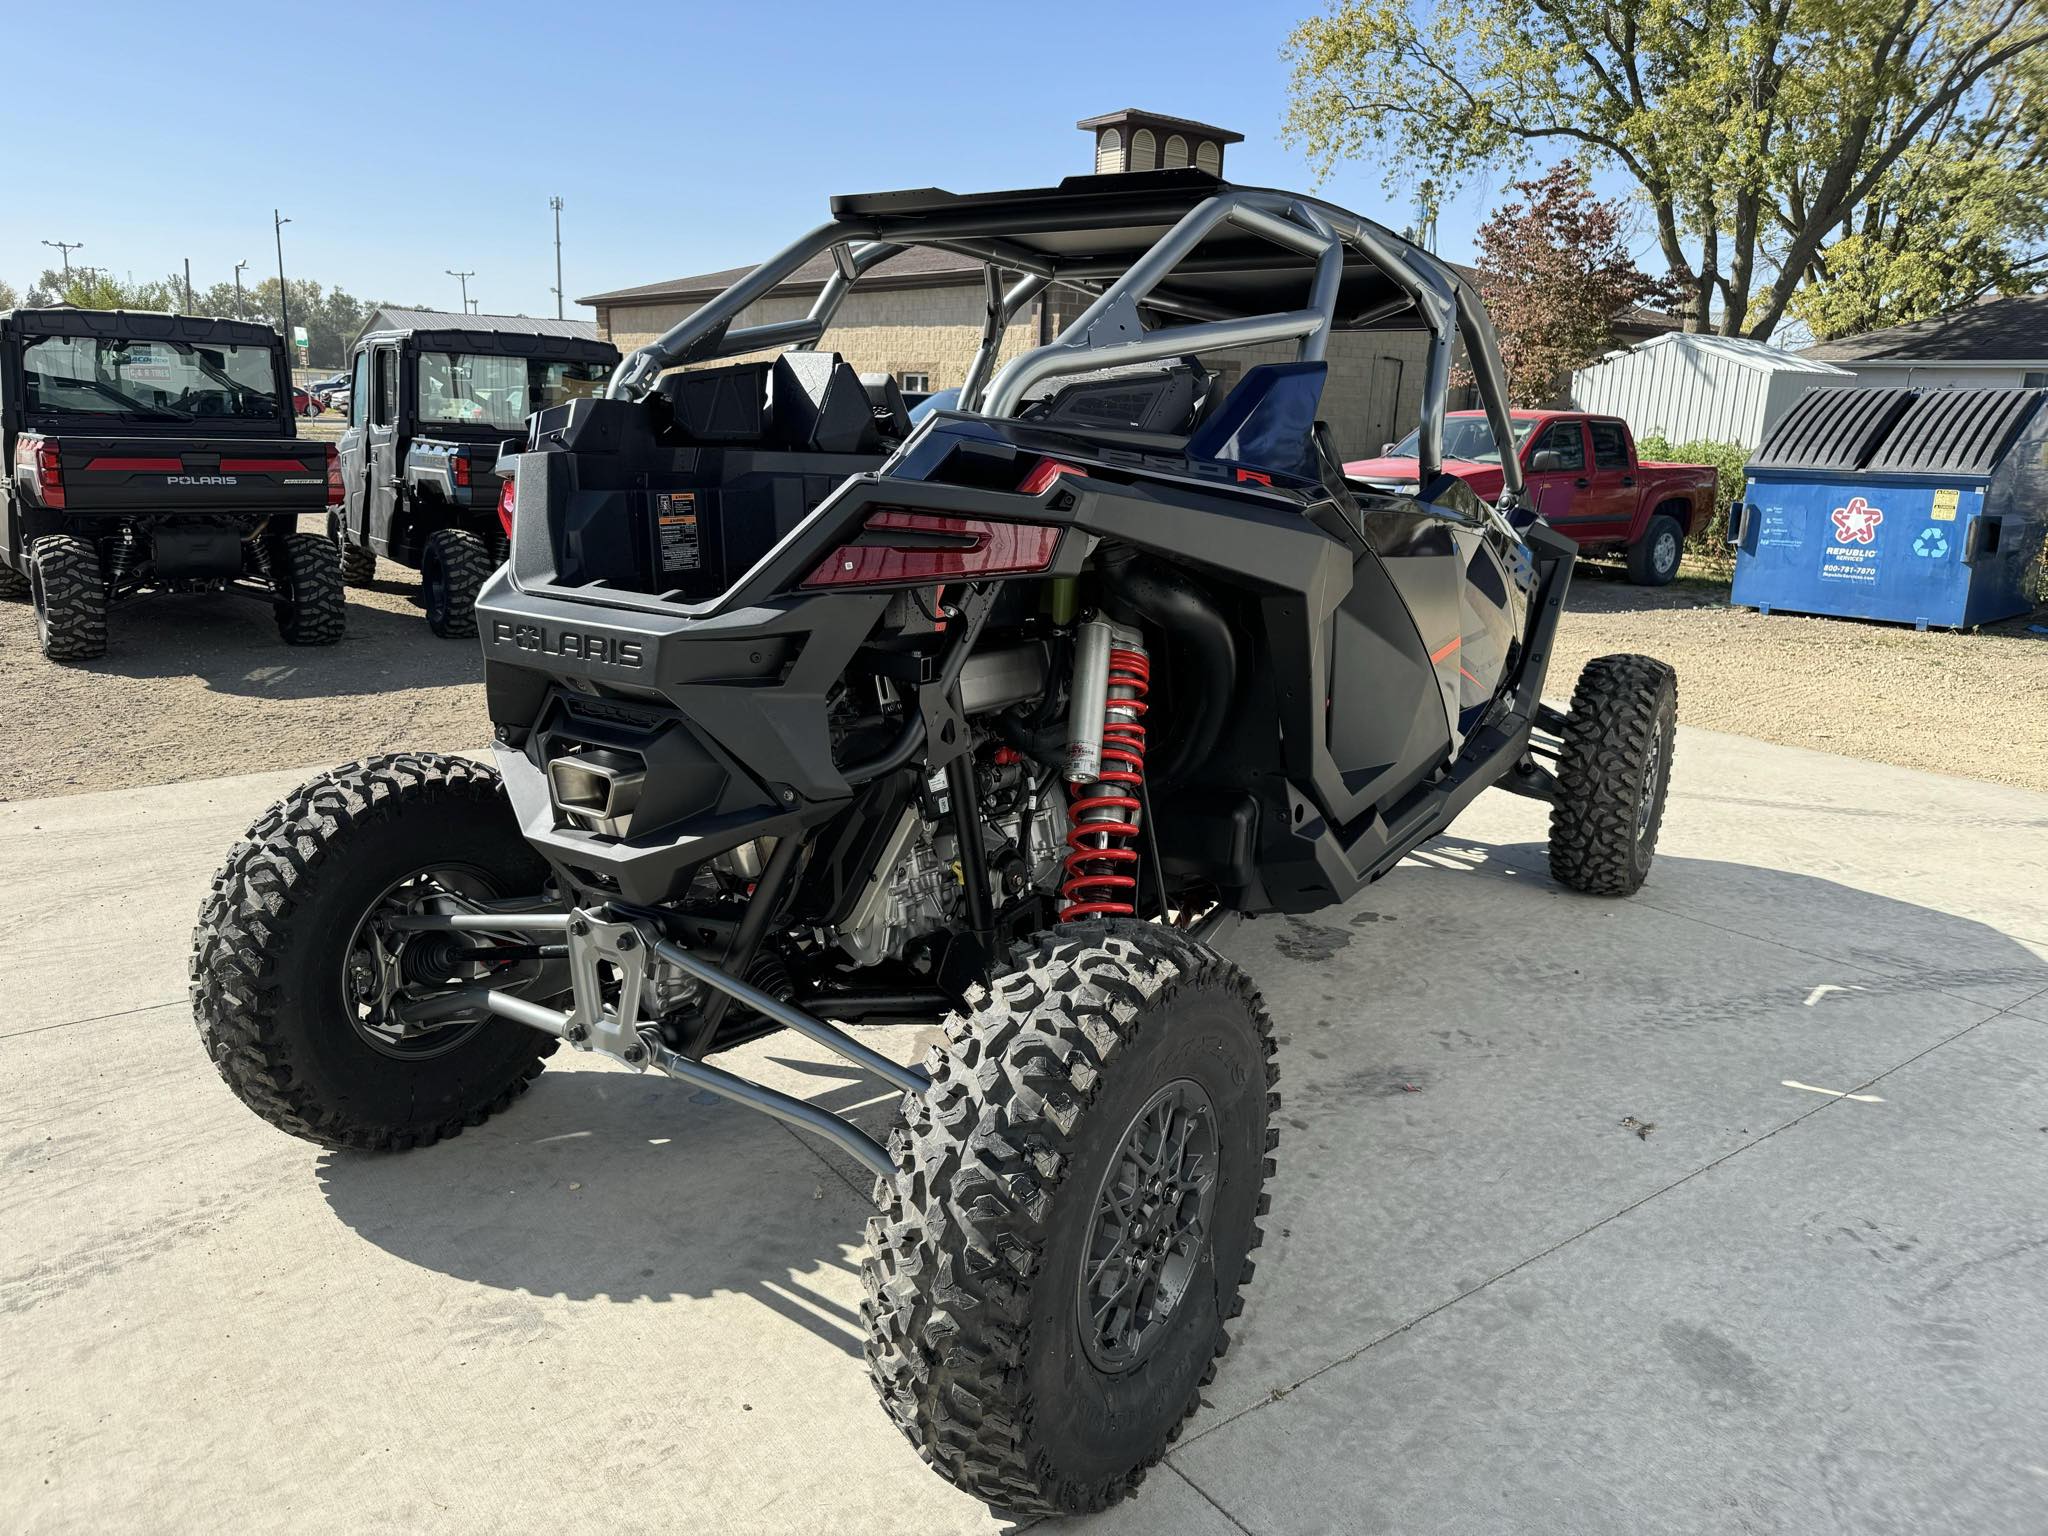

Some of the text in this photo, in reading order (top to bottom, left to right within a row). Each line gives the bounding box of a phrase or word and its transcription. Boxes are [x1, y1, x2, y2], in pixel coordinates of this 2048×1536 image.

[167, 476, 237, 485] POLARIS
[1236, 468, 1274, 488] R
[1826, 547, 1876, 558] REPUBLIC
[1835, 555, 1864, 563] SERVICES
[1823, 564, 1876, 575] 800-781-7870
[493, 620, 643, 669] POLARIS
